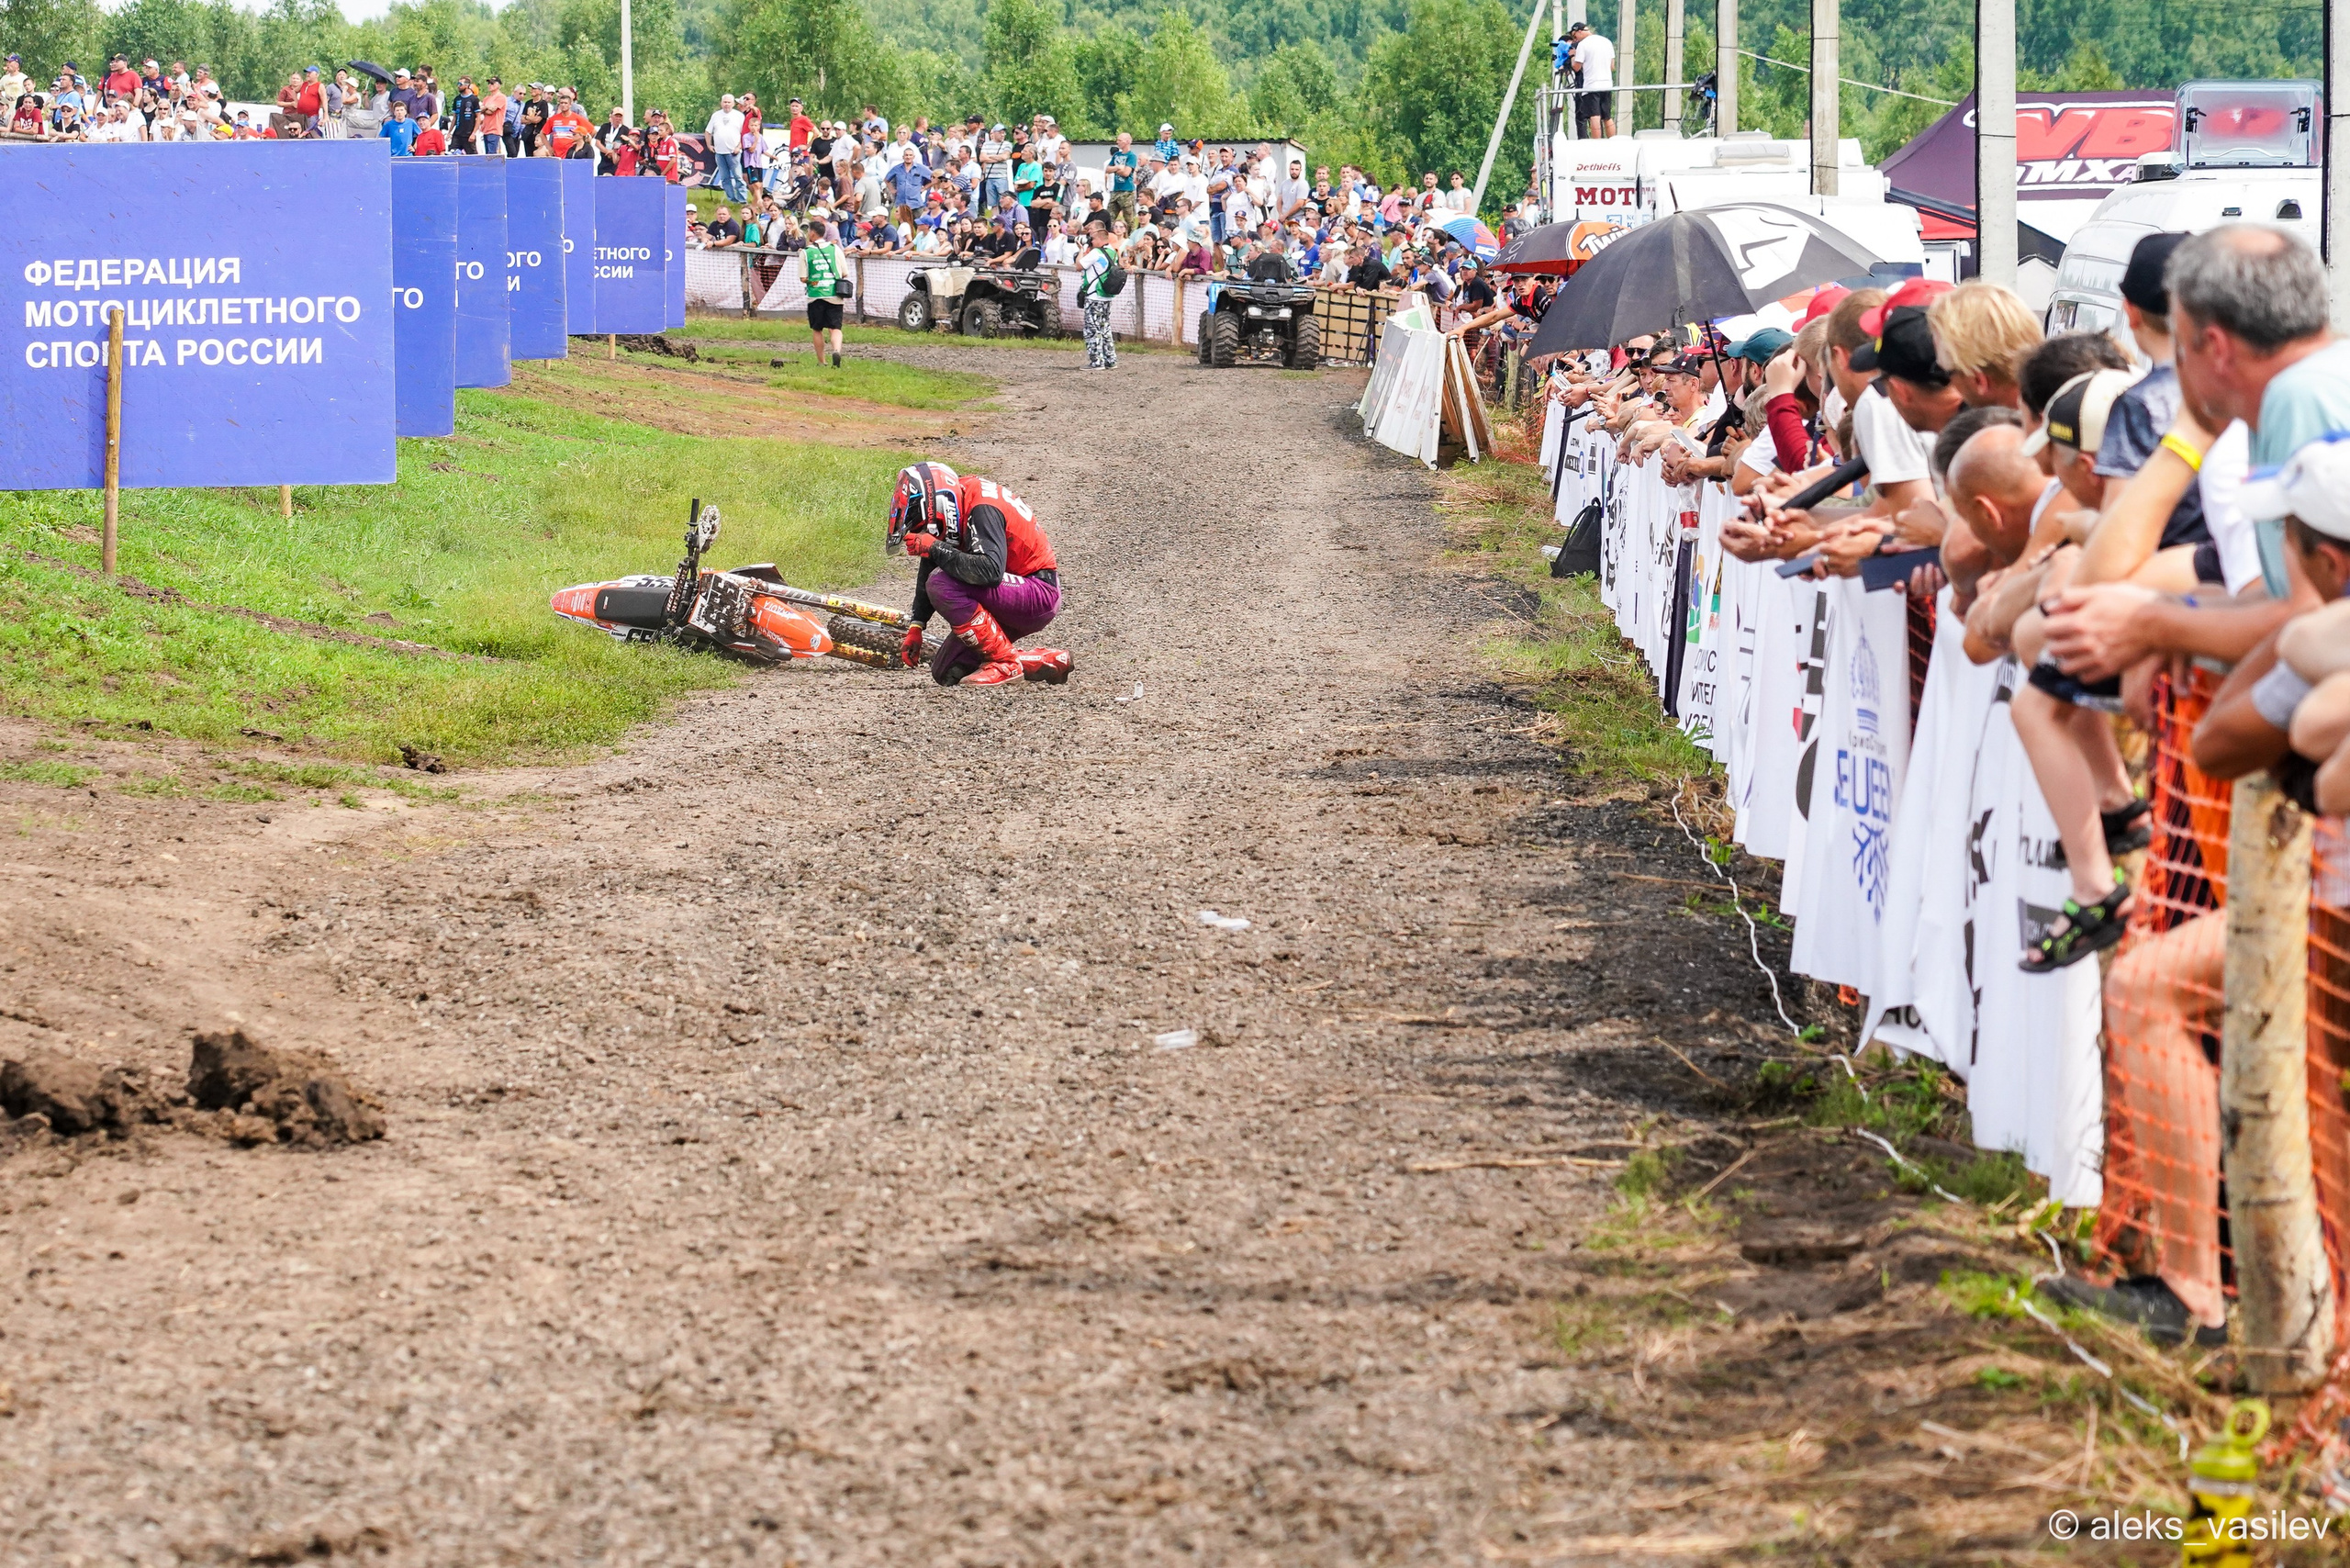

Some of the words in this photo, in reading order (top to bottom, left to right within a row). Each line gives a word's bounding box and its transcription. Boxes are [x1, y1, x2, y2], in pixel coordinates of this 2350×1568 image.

[24, 257, 241, 290] ФЕДЕРАЦИЯ
[25, 296, 362, 330] МОТОЦИКЛЕТНОГО
[25, 340, 166, 368] СПОТА
[177, 337, 323, 366] РОССИИ
